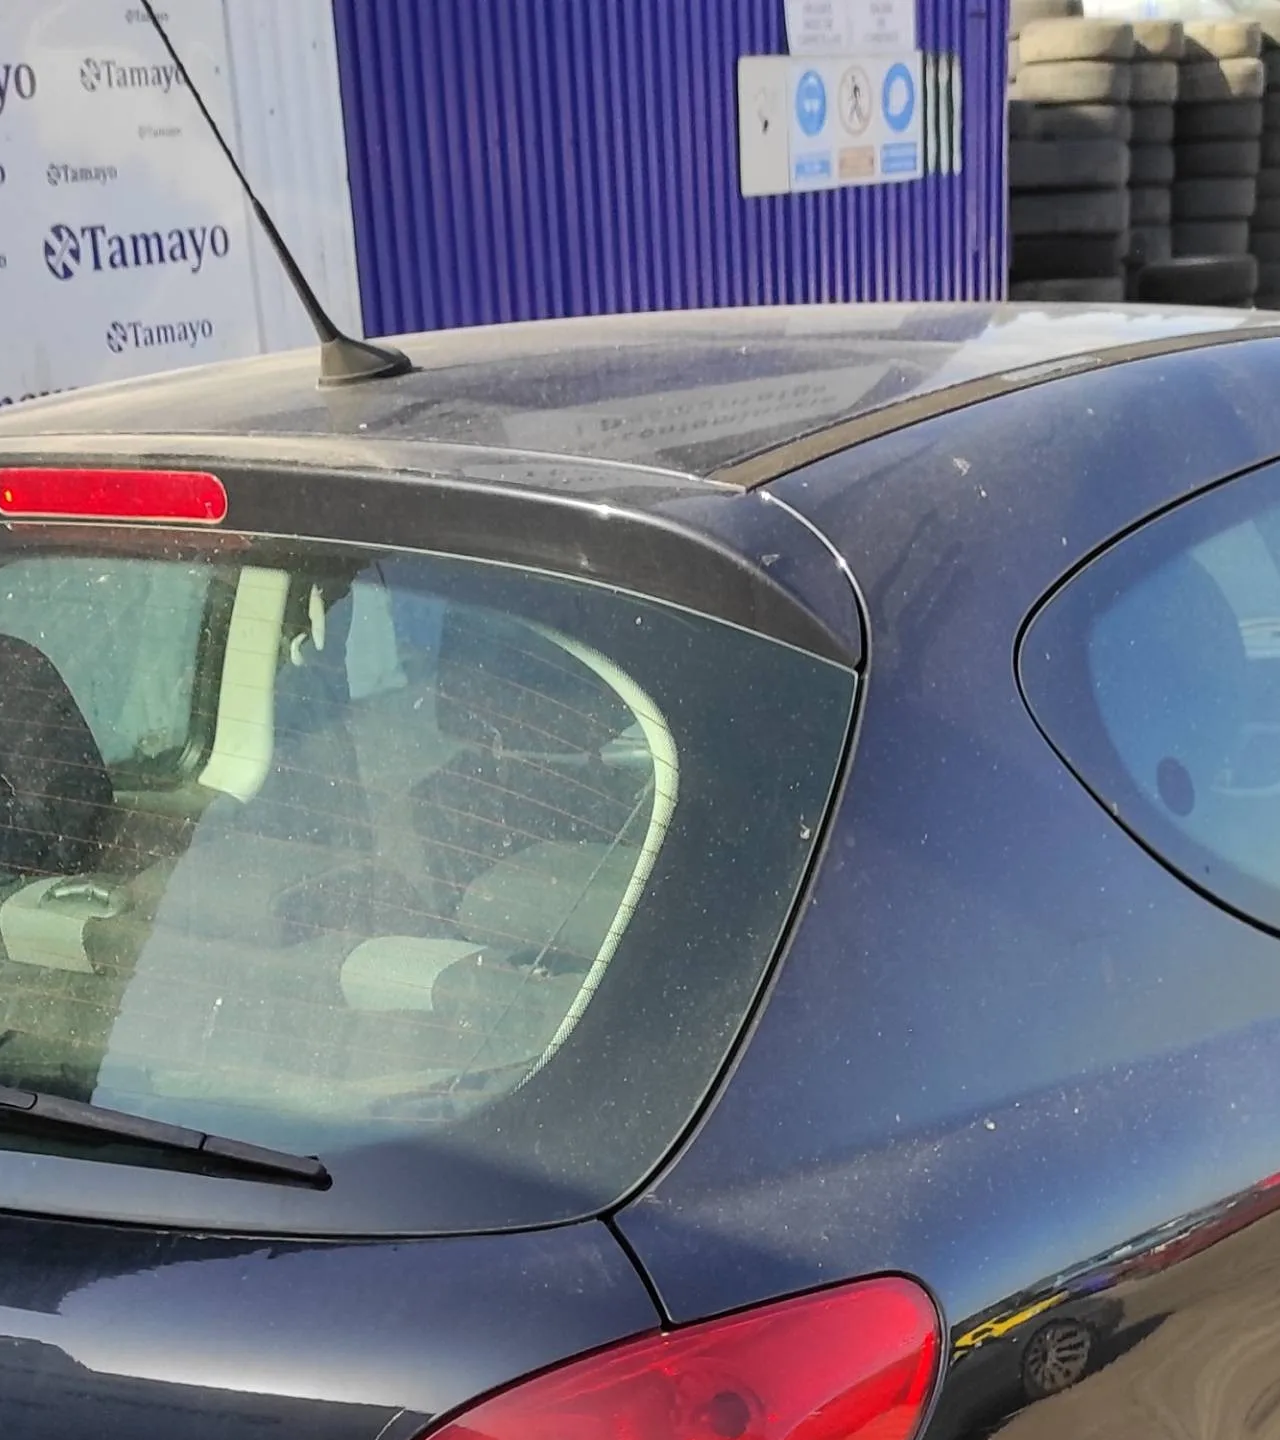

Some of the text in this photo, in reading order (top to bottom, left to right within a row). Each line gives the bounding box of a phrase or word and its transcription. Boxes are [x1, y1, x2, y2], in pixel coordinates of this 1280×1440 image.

[61, 163, 118, 185] Tamayo
[80, 225, 229, 274] Tamayo
[127, 319, 213, 348] Tamayo
